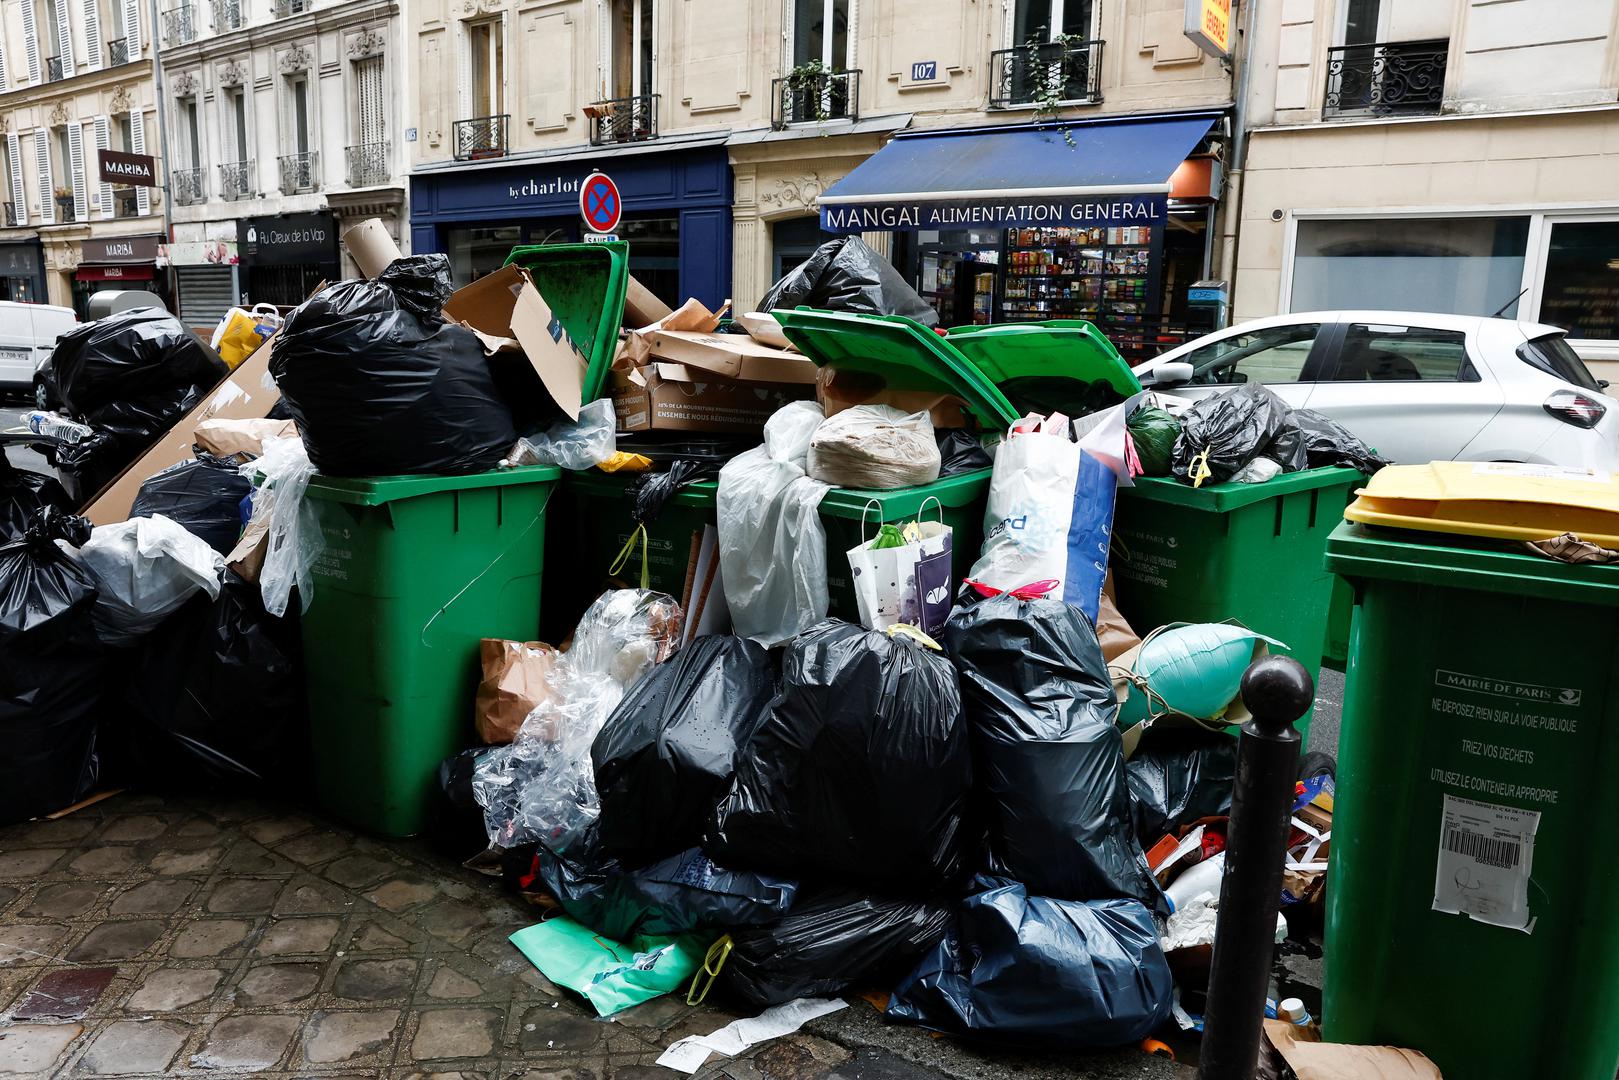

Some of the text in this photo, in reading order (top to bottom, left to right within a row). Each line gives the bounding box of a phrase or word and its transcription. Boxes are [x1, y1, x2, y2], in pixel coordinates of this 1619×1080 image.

[914, 64, 934, 79] 107
[105, 161, 150, 176] MARIBÀ
[509, 176, 578, 199] by charlot
[827, 202, 1160, 228] MANGAI ALIMENTATION GENERAL
[106, 242, 133, 256] MARIBÀ
[657, 411, 690, 420] ENSEMBLE
[1447, 675, 1552, 699] MAIRIE DE PARIS
[1432, 698, 1577, 733] NE DEPOSEZ RIEN SUR LA VOIE PUBLIQUE
[1462, 739, 1534, 764] TRIEZ VOS DECHETS
[1430, 768, 1558, 804] UTILISEZ LE CONTENEUR APPROPRIE
